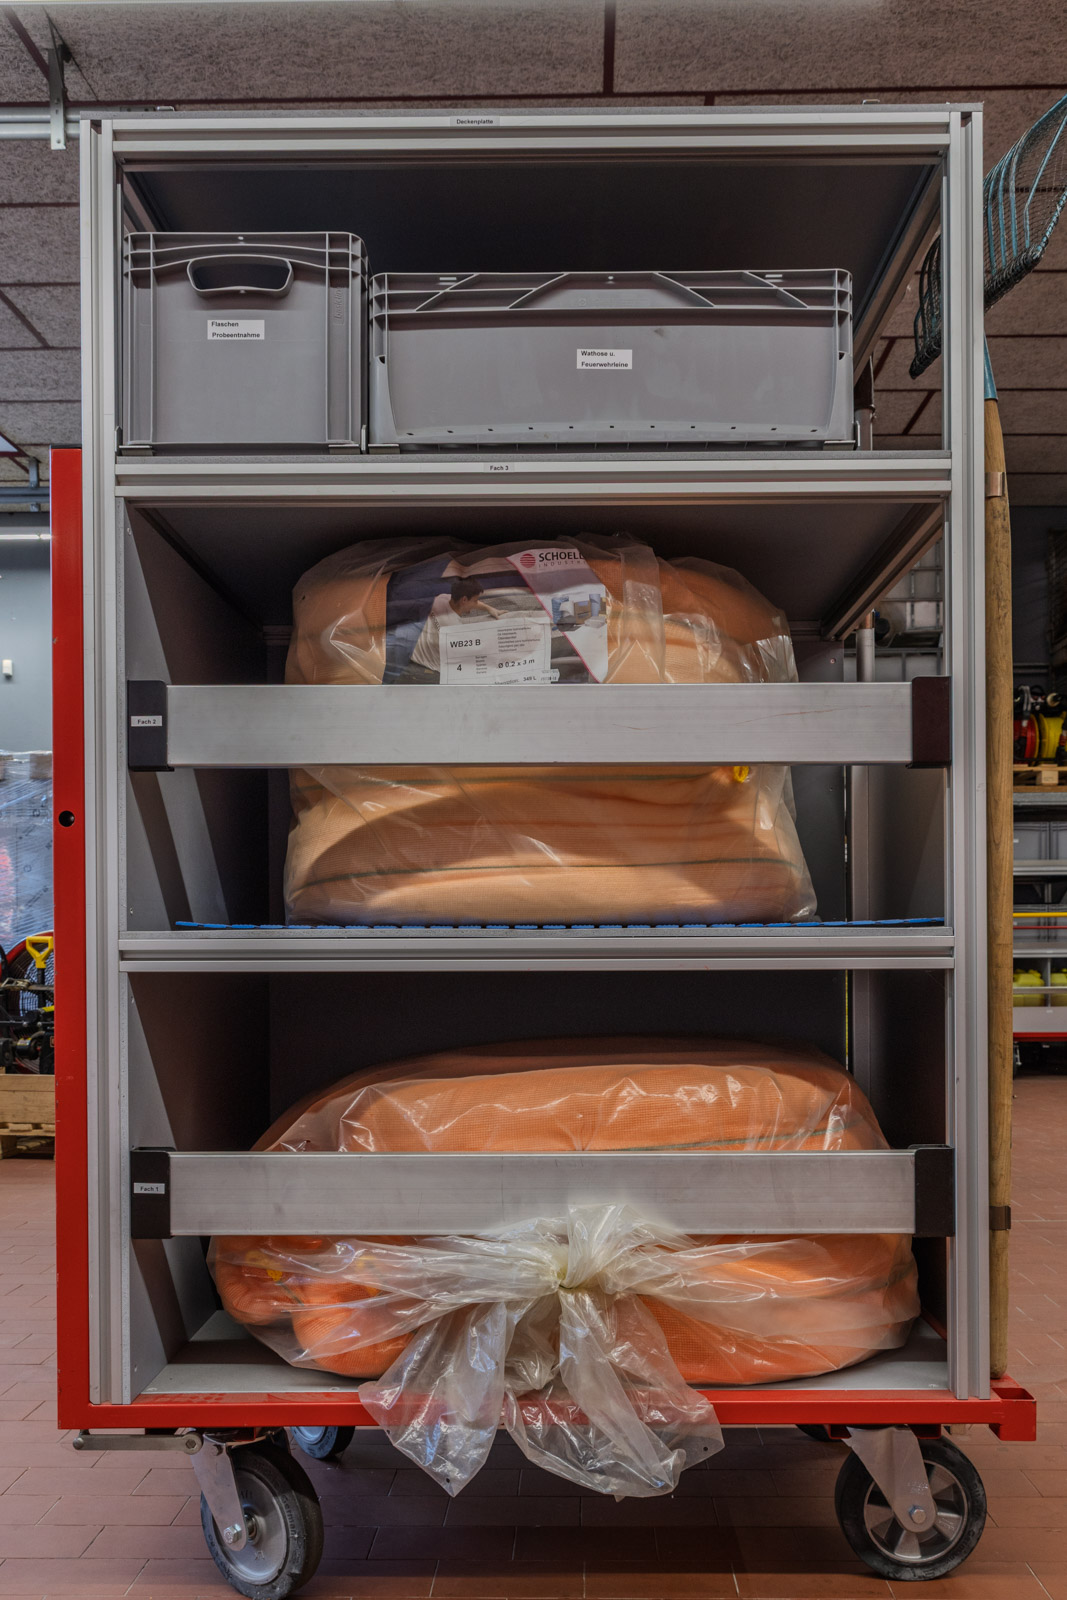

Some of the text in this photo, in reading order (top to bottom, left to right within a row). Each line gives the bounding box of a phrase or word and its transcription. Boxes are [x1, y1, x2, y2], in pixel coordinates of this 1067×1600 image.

[449, 638, 481, 648] WB23 B
[456, 663, 462, 671] 4
